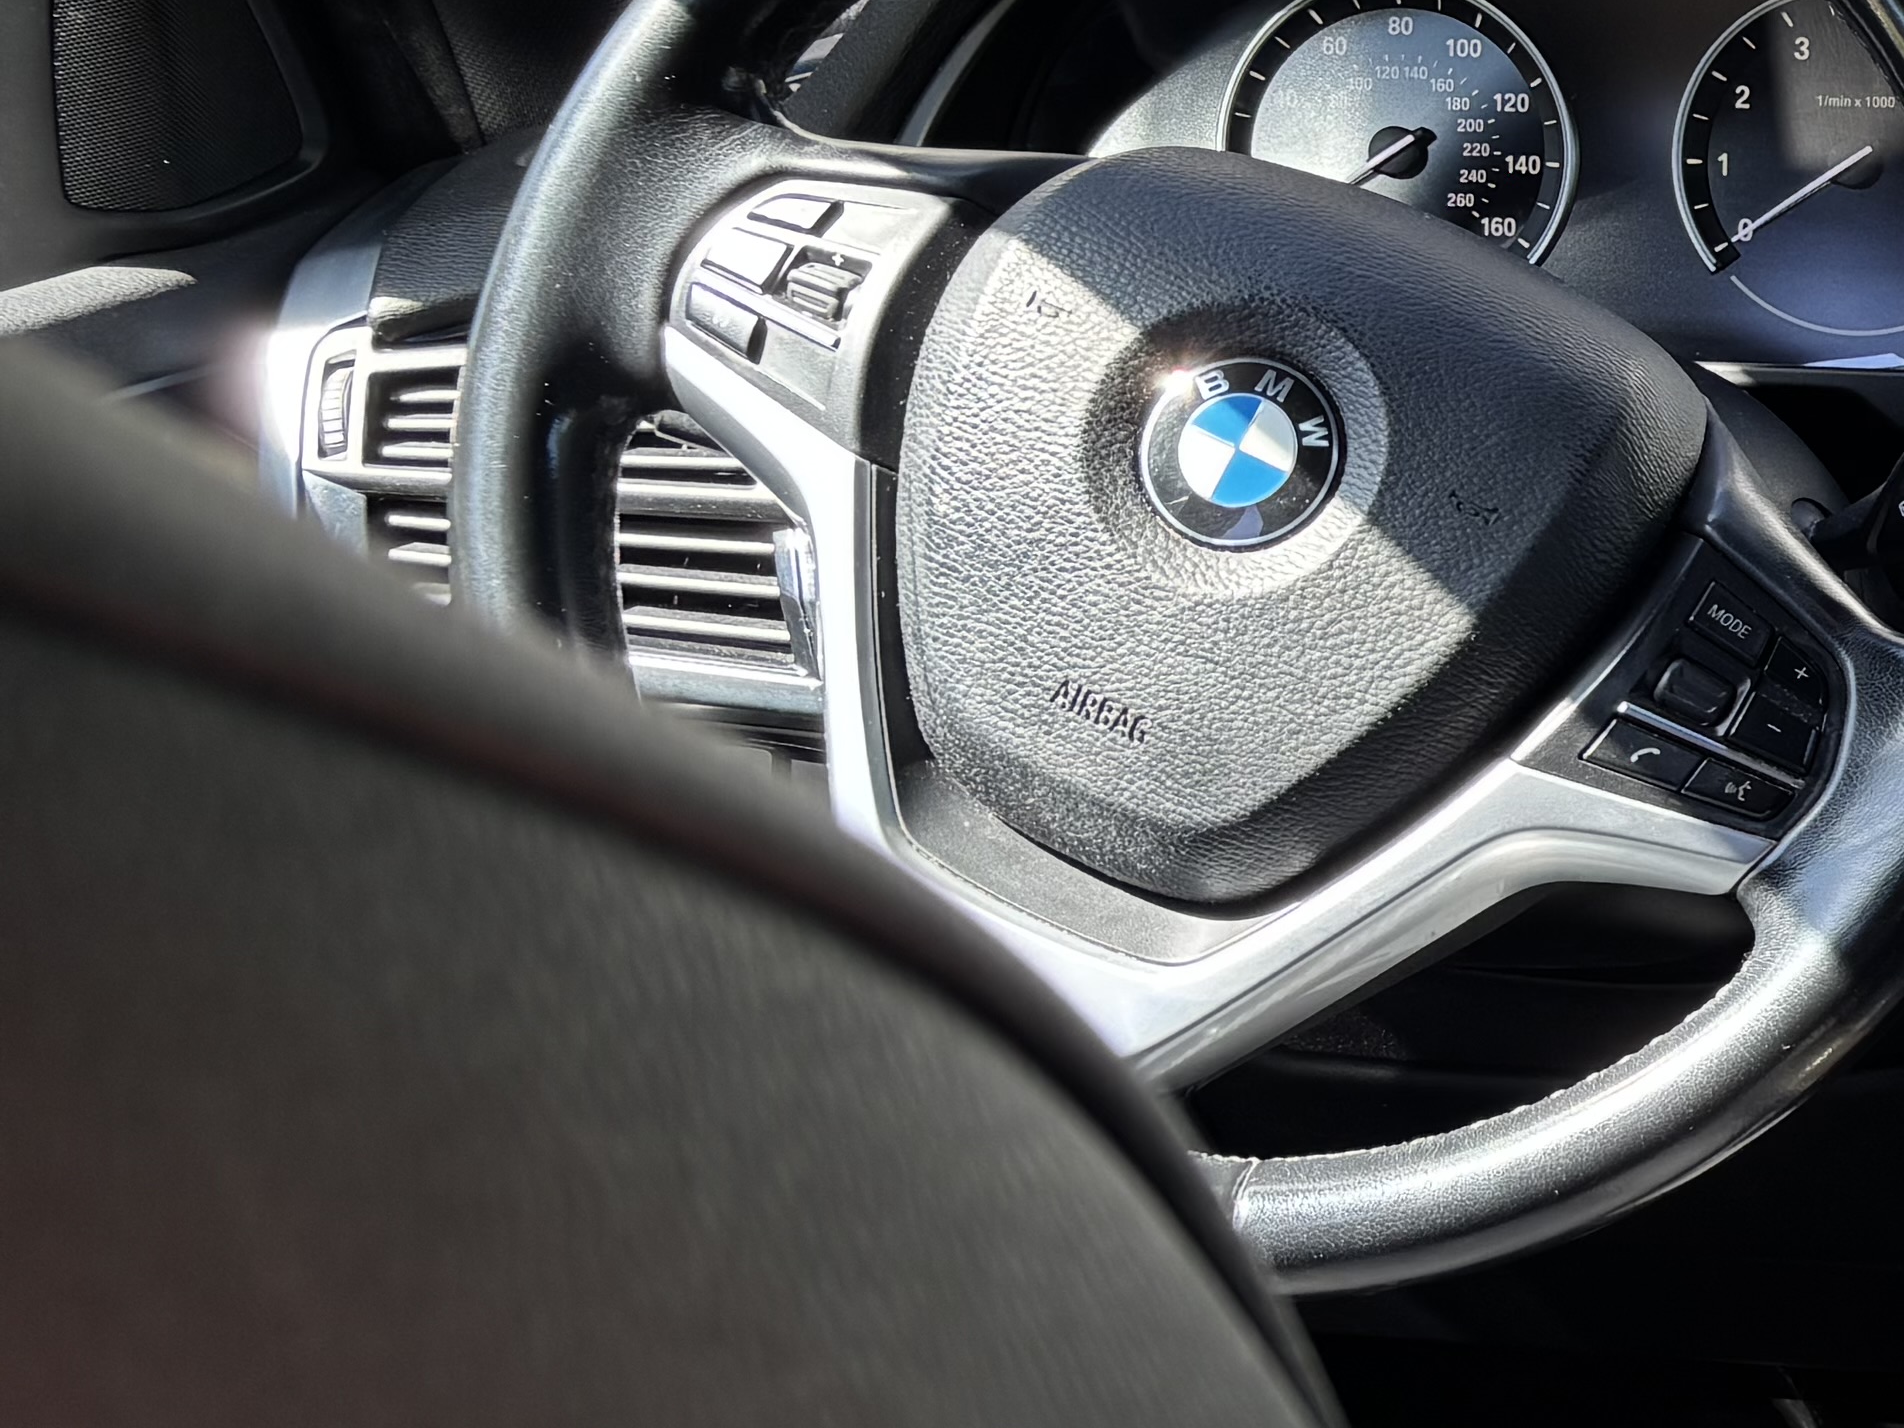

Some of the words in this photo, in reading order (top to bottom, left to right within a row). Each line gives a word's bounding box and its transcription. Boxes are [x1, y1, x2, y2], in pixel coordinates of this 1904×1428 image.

[1387, 17, 1413, 35] 80
[1323, 37, 1347, 56] 60
[1446, 39, 1482, 58] 100
[1794, 37, 1810, 60] 3
[1375, 66, 1399, 79] 120
[1404, 66, 1428, 79] 140
[1430, 78, 1454, 92] 160
[1446, 97, 1470, 110] 180
[1493, 93, 1530, 112] 120
[1734, 85, 1751, 109] 2
[1816, 95, 1851, 107] 1/min
[1854, 99, 1862, 107] x
[1865, 96, 1896, 108] 1000
[1457, 119, 1484, 132] 200
[1463, 143, 1490, 156] 220
[1505, 155, 1541, 174] 140
[1717, 154, 1729, 176] 1
[1460, 169, 1487, 183] 240
[1447, 193, 1475, 207] 260
[1481, 217, 1516, 236] 160
[1737, 219, 1754, 241] 0
[1195, 369, 1329, 448] BMW
[1706, 603, 1752, 640] MODE
[1050, 679, 1151, 744] AIRBAG
